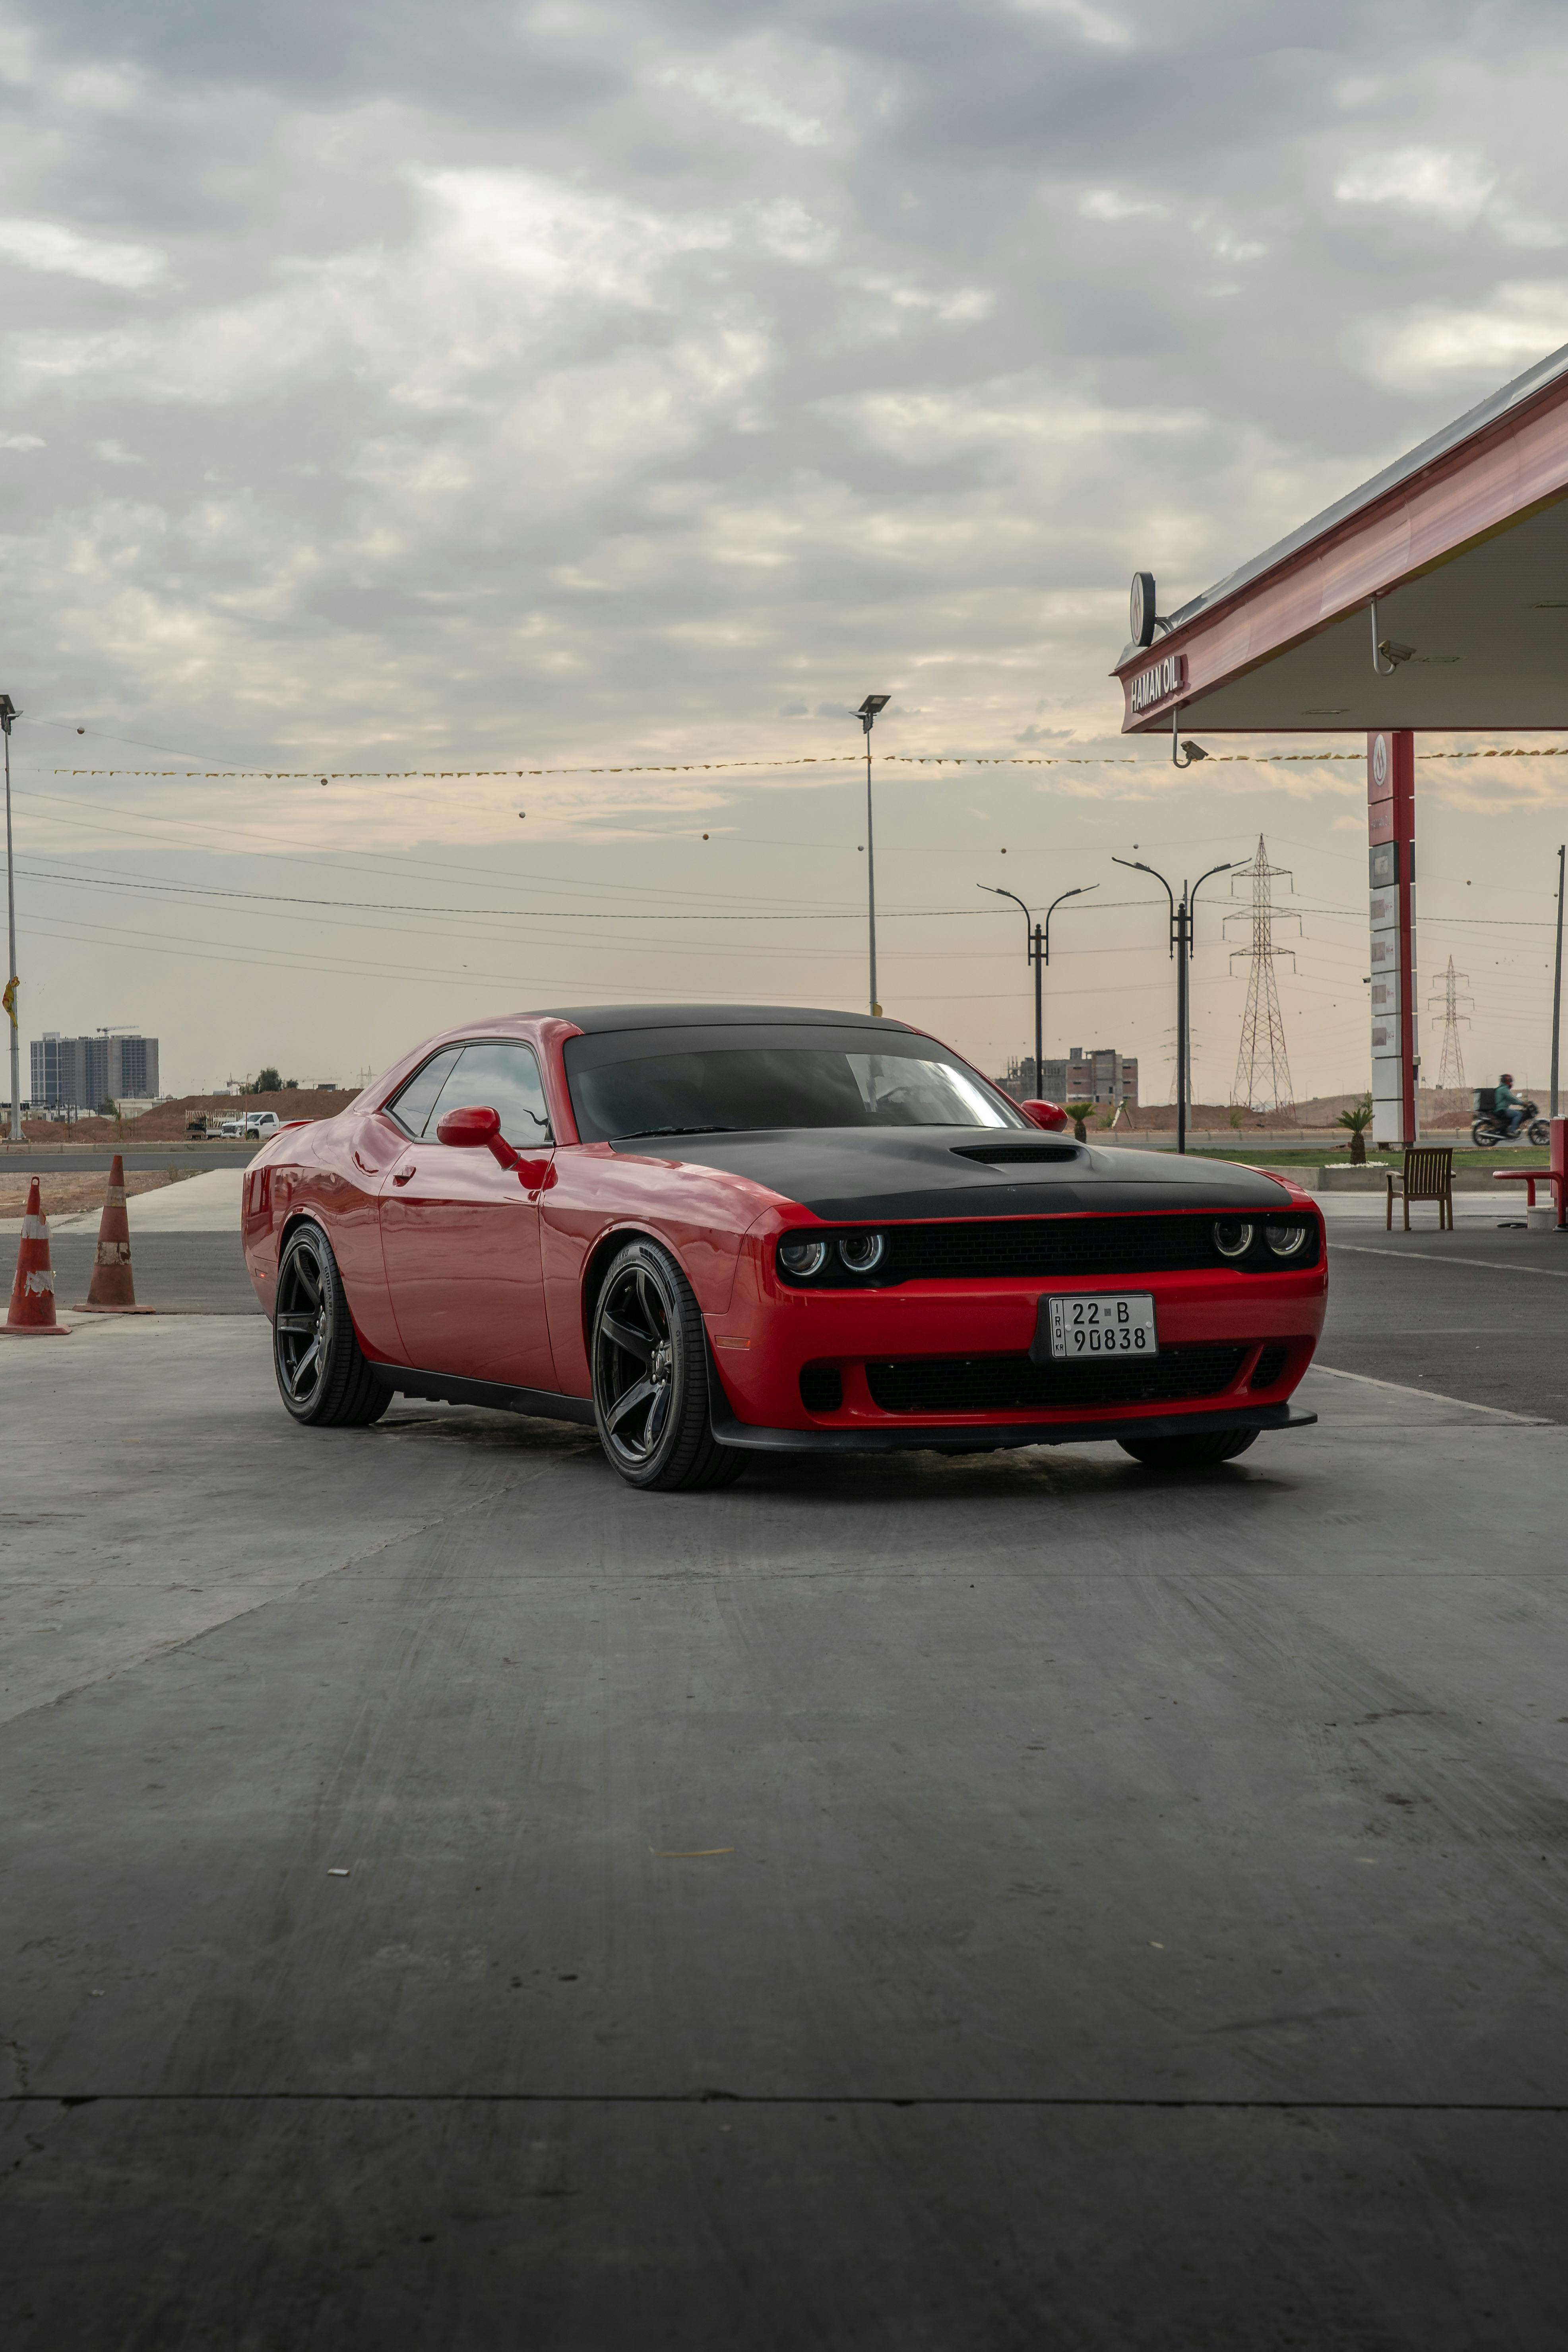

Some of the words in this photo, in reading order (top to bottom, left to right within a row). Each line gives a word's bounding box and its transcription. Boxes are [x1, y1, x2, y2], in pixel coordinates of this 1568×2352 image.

[1131, 665, 1161, 713] HAMAN
[1163, 656, 1178, 693] OIL
[1073, 1303, 1100, 1324] 22
[1116, 1301, 1129, 1323] B
[1074, 1328, 1146, 1351] 90838
